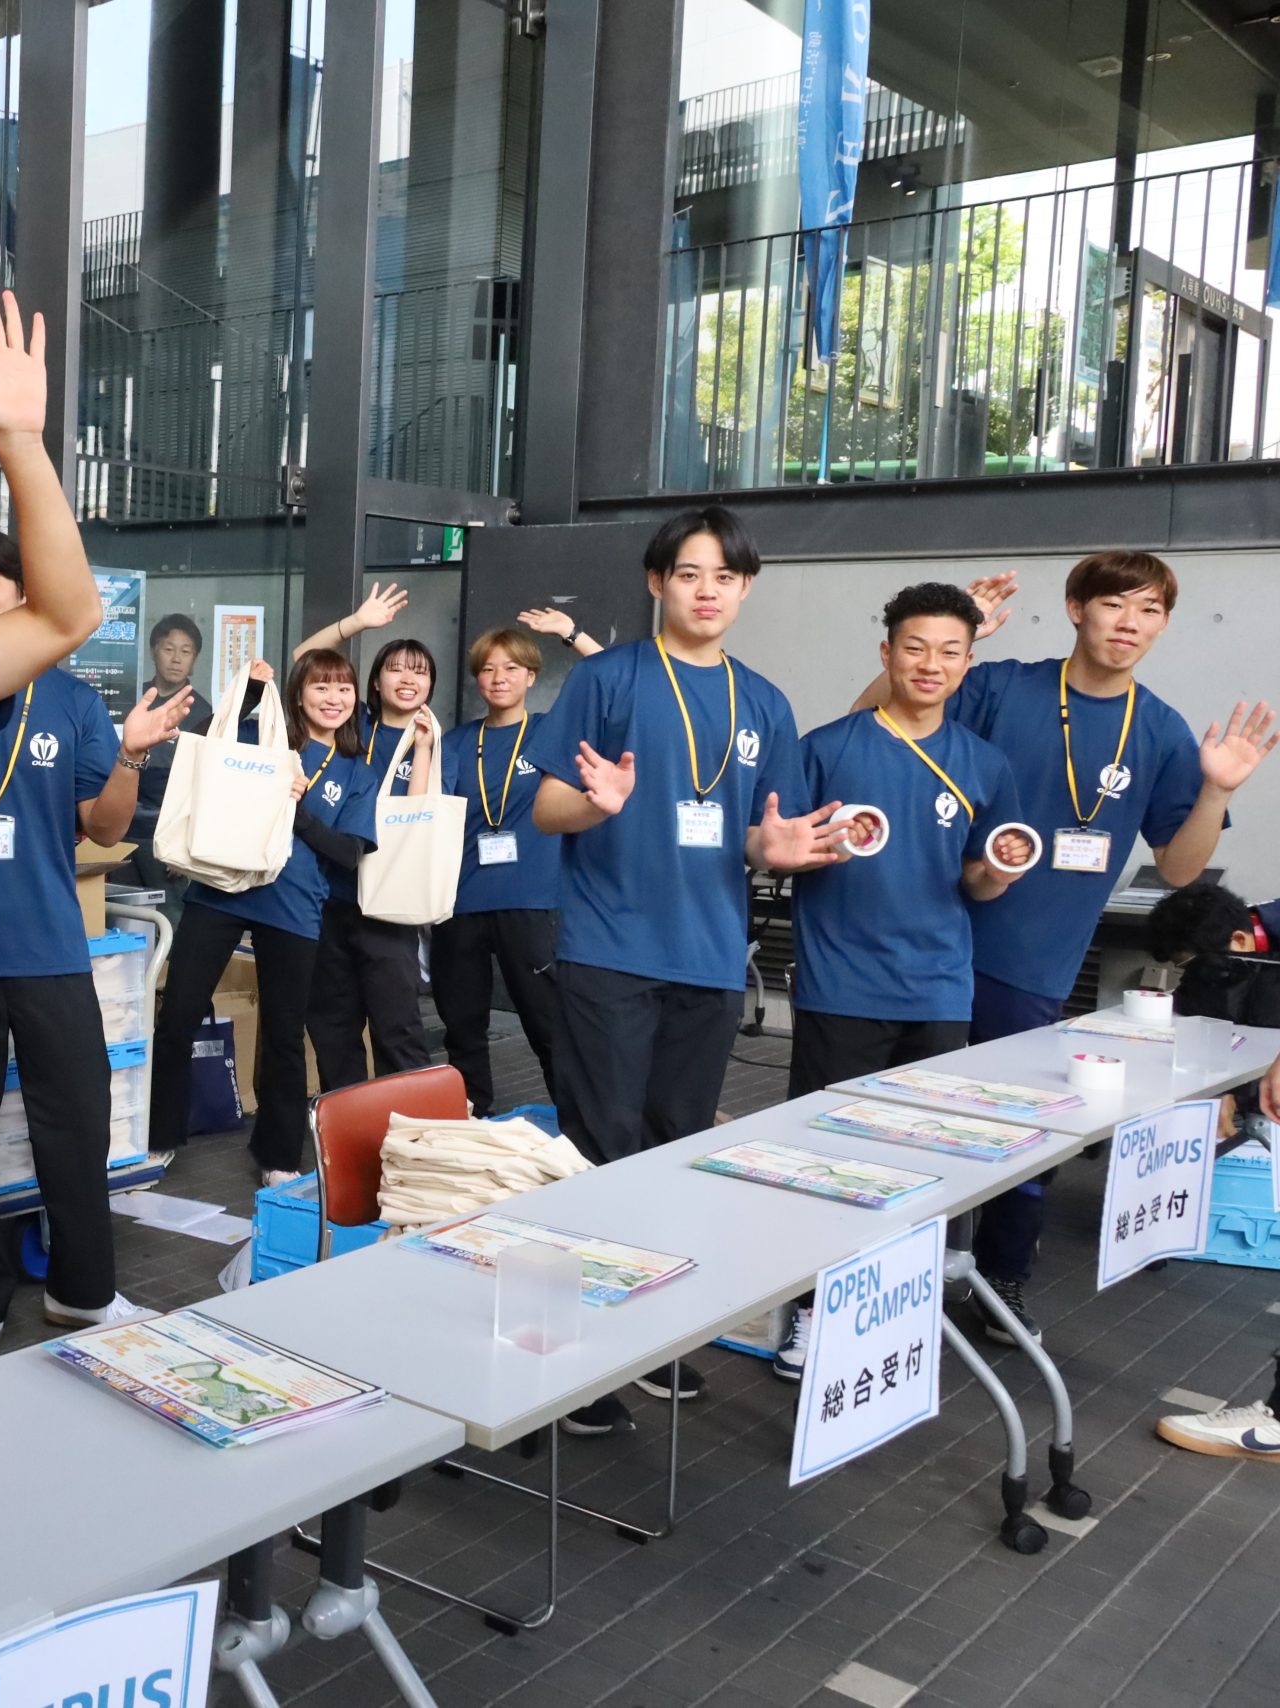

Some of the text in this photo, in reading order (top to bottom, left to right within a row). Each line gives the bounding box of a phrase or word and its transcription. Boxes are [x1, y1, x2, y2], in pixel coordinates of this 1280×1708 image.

[31, 760, 55, 768] OUHS
[224, 757, 276, 775] OUHS
[384, 811, 434, 825] OUHS
[1120, 1124, 1157, 1160] OPEN
[1137, 1138, 1202, 1179] CAMPUS
[1115, 1188, 1189, 1244] 総合受付
[826, 1260, 881, 1314] OPEN
[854, 1269, 932, 1337] CAMPUS
[75, 1356, 104, 1371] 2023
[97, 1367, 144, 1392] CAMPUS
[820, 1337, 924, 1424] 総合受付
[134, 1387, 168, 1406] OPEN
